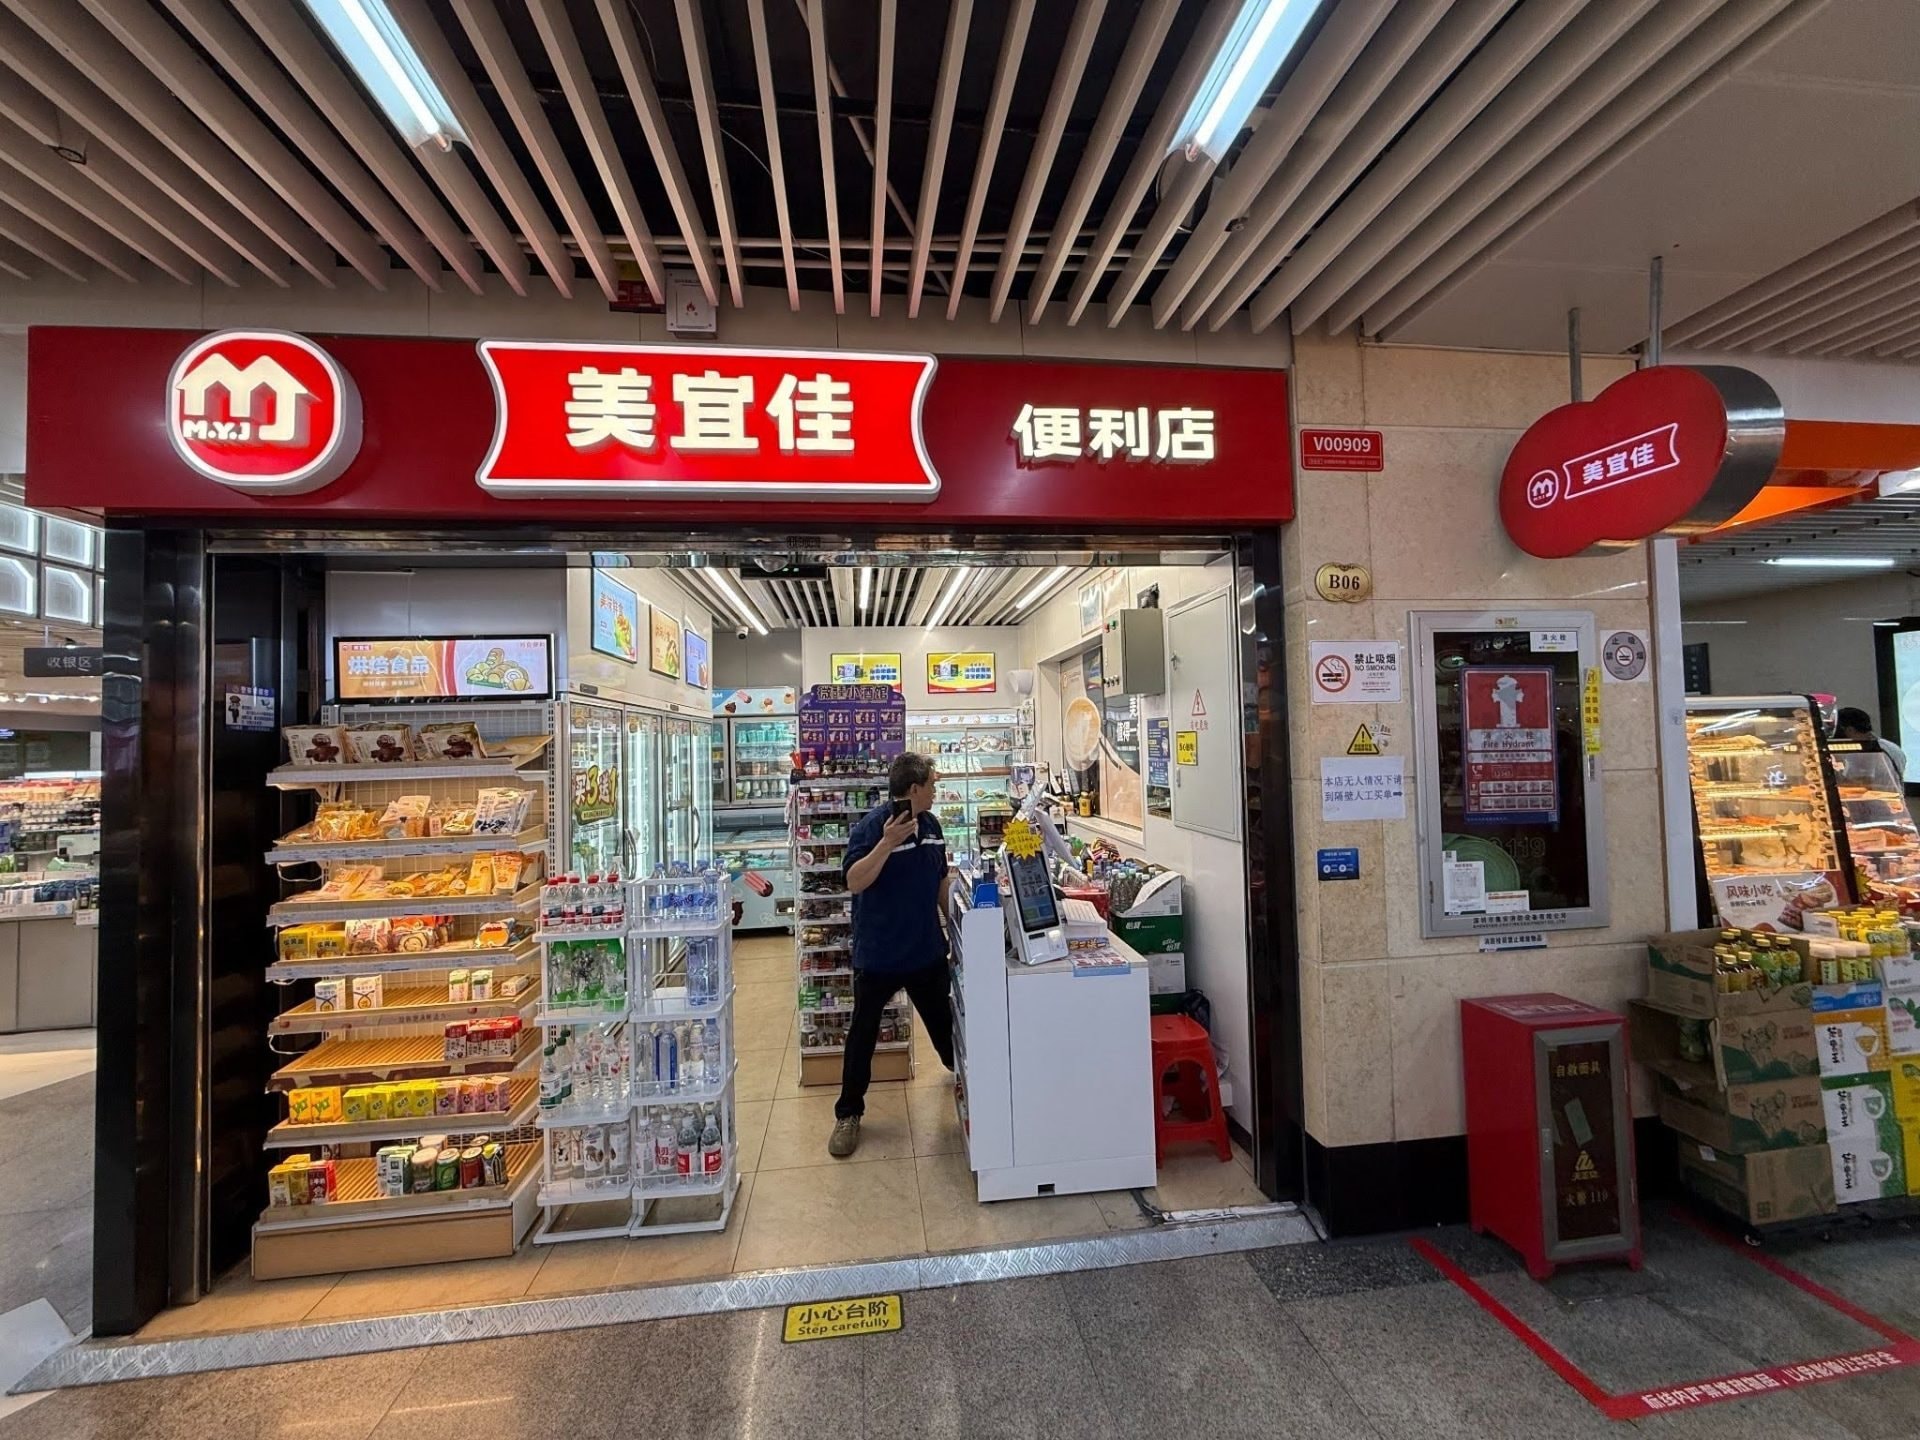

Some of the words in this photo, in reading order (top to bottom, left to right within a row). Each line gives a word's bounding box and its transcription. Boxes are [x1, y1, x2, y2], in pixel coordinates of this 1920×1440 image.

[564, 366, 855, 453] 美宜佳
[1011, 402, 1216, 462] 便利店
[1313, 436, 1371, 452] V00909
[1582, 443, 1655, 485] 美宜佳
[1329, 574, 1360, 590] B06
[47, 656, 92, 669] 收银区
[347, 655, 430, 675] 烘焙食品
[1354, 653, 1396, 664] 禁止吸烟
[1502, 741, 1534, 749] Hydrant
[1324, 774, 1402, 787] 本店无人情况下请
[1324, 790, 1392, 802] 到隔壁人工买单
[1726, 884, 1774, 899] 风味小吃
[799, 1301, 888, 1325] 小心台阶
[798, 1325, 828, 1335] Step
[831, 1317, 889, 1331] carefully
